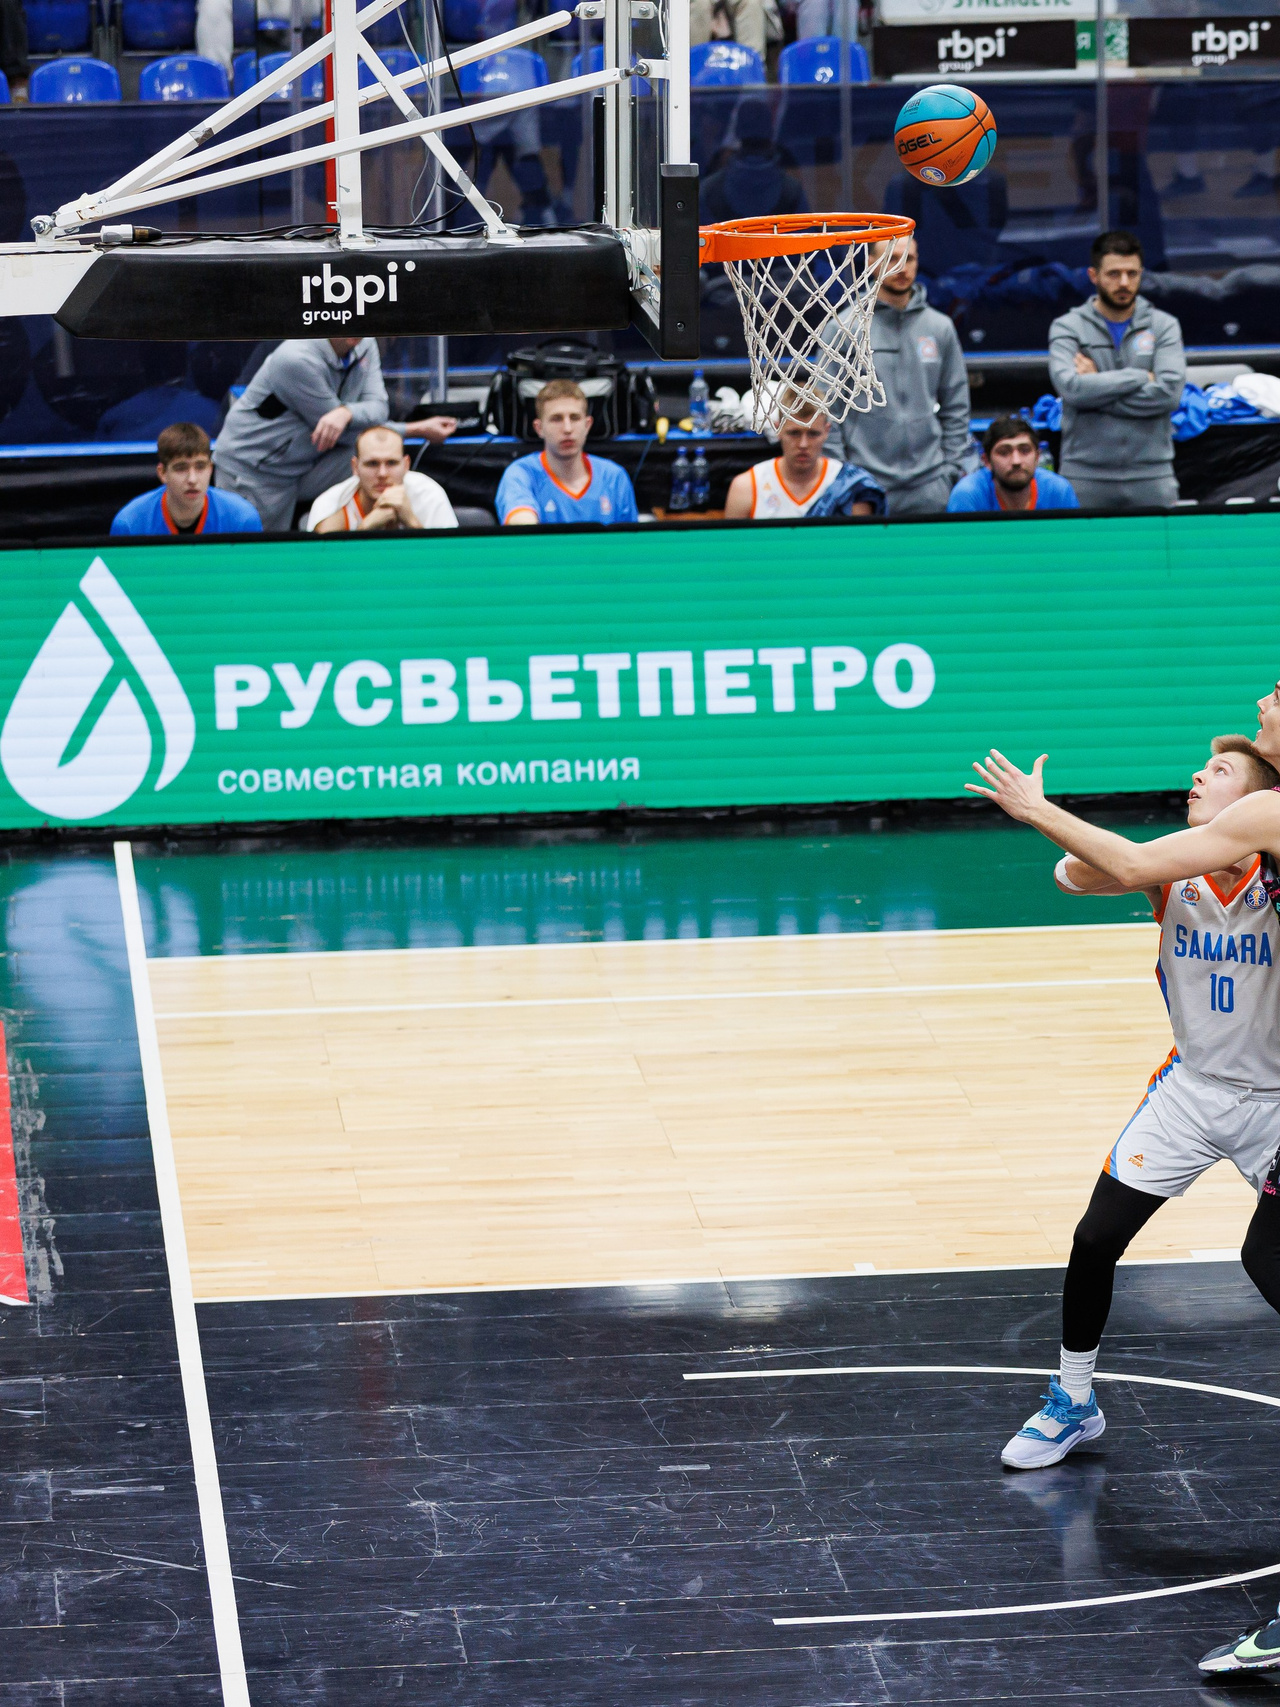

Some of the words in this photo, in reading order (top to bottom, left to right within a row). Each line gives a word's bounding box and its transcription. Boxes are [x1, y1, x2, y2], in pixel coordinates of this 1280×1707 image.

[938, 27, 1018, 67] rbpi
[1192, 21, 1271, 60] rbpi
[897, 132, 943, 157] ÖGEL
[302, 261, 415, 316] rbpi
[303, 310, 352, 326] group
[214, 643, 936, 731] РУСВЬЕТПЕТРО
[217, 764, 442, 795] совместная
[457, 756, 640, 786] компания
[1174, 923, 1273, 968] SAMARA
[1210, 973, 1235, 1014] 10
